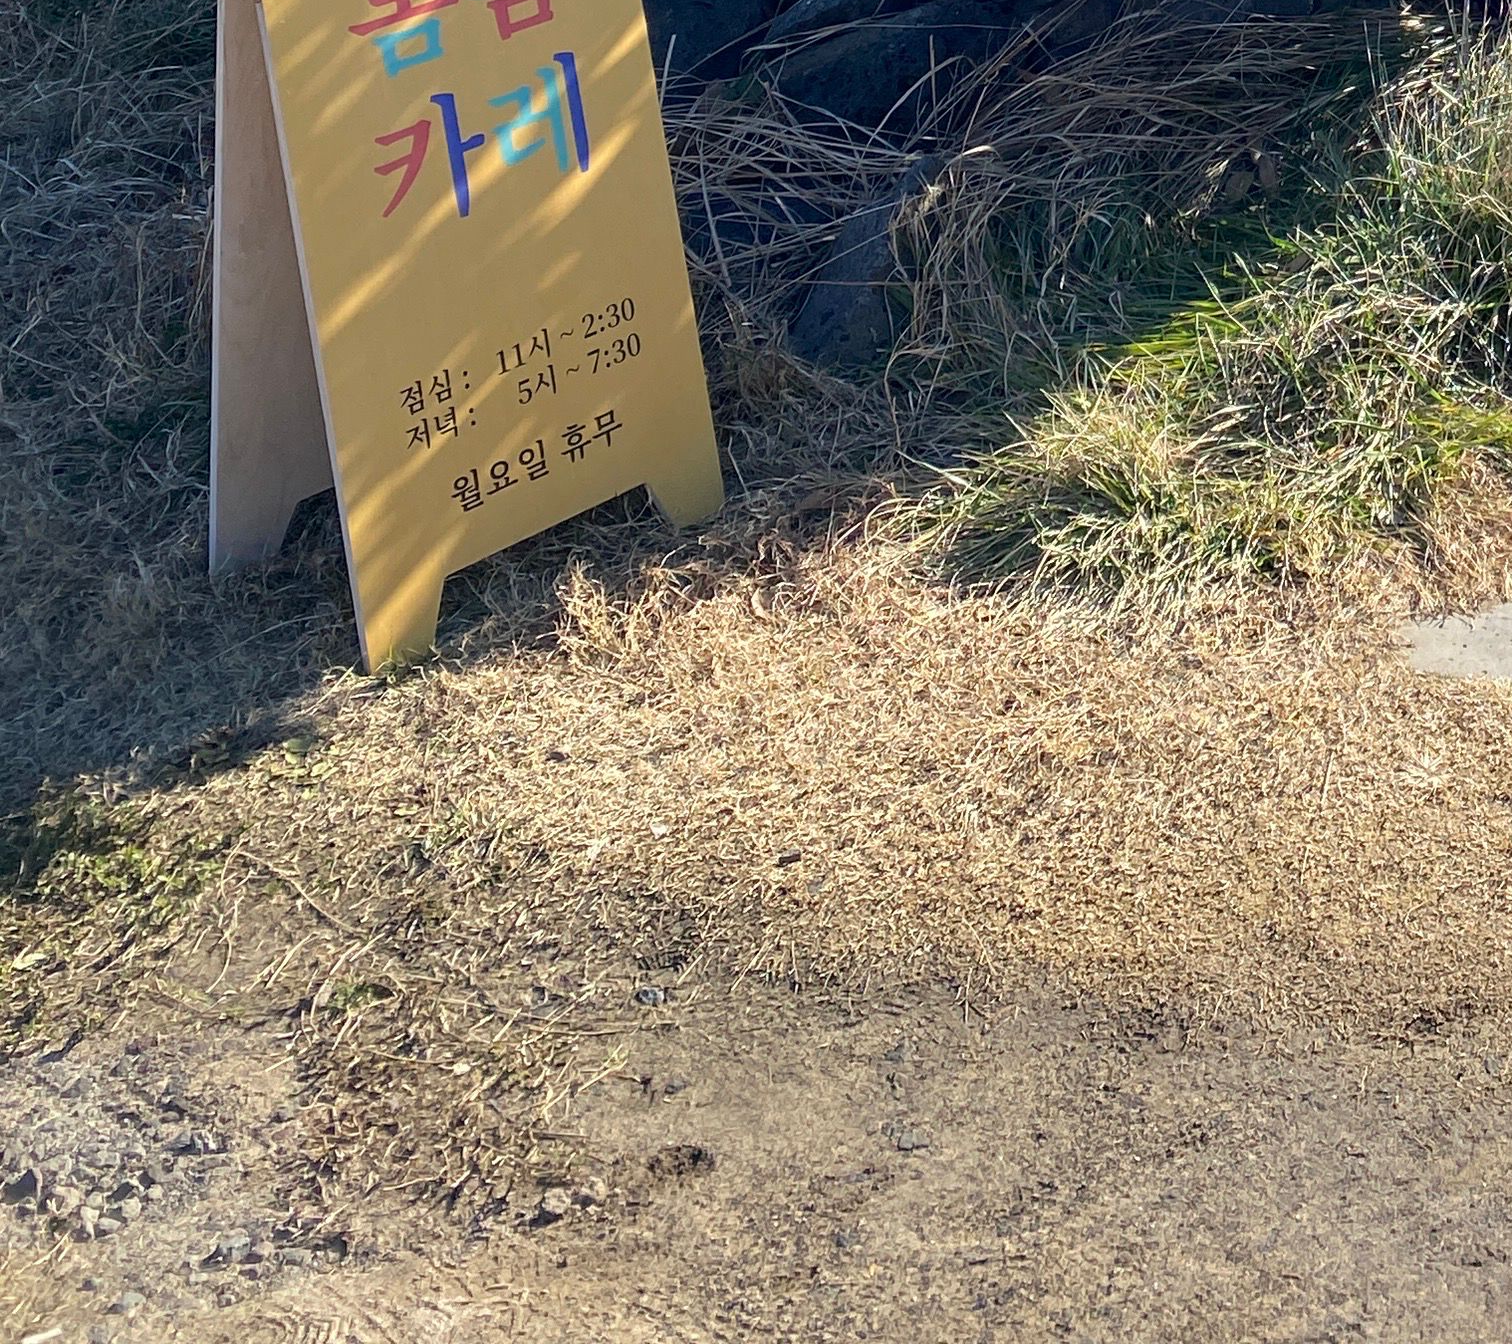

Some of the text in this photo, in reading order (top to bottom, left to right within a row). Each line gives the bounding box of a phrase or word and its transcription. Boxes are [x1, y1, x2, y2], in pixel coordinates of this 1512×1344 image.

[373, 52, 590, 218] 카레
[451, 409, 623, 512] 월요일 휴무
